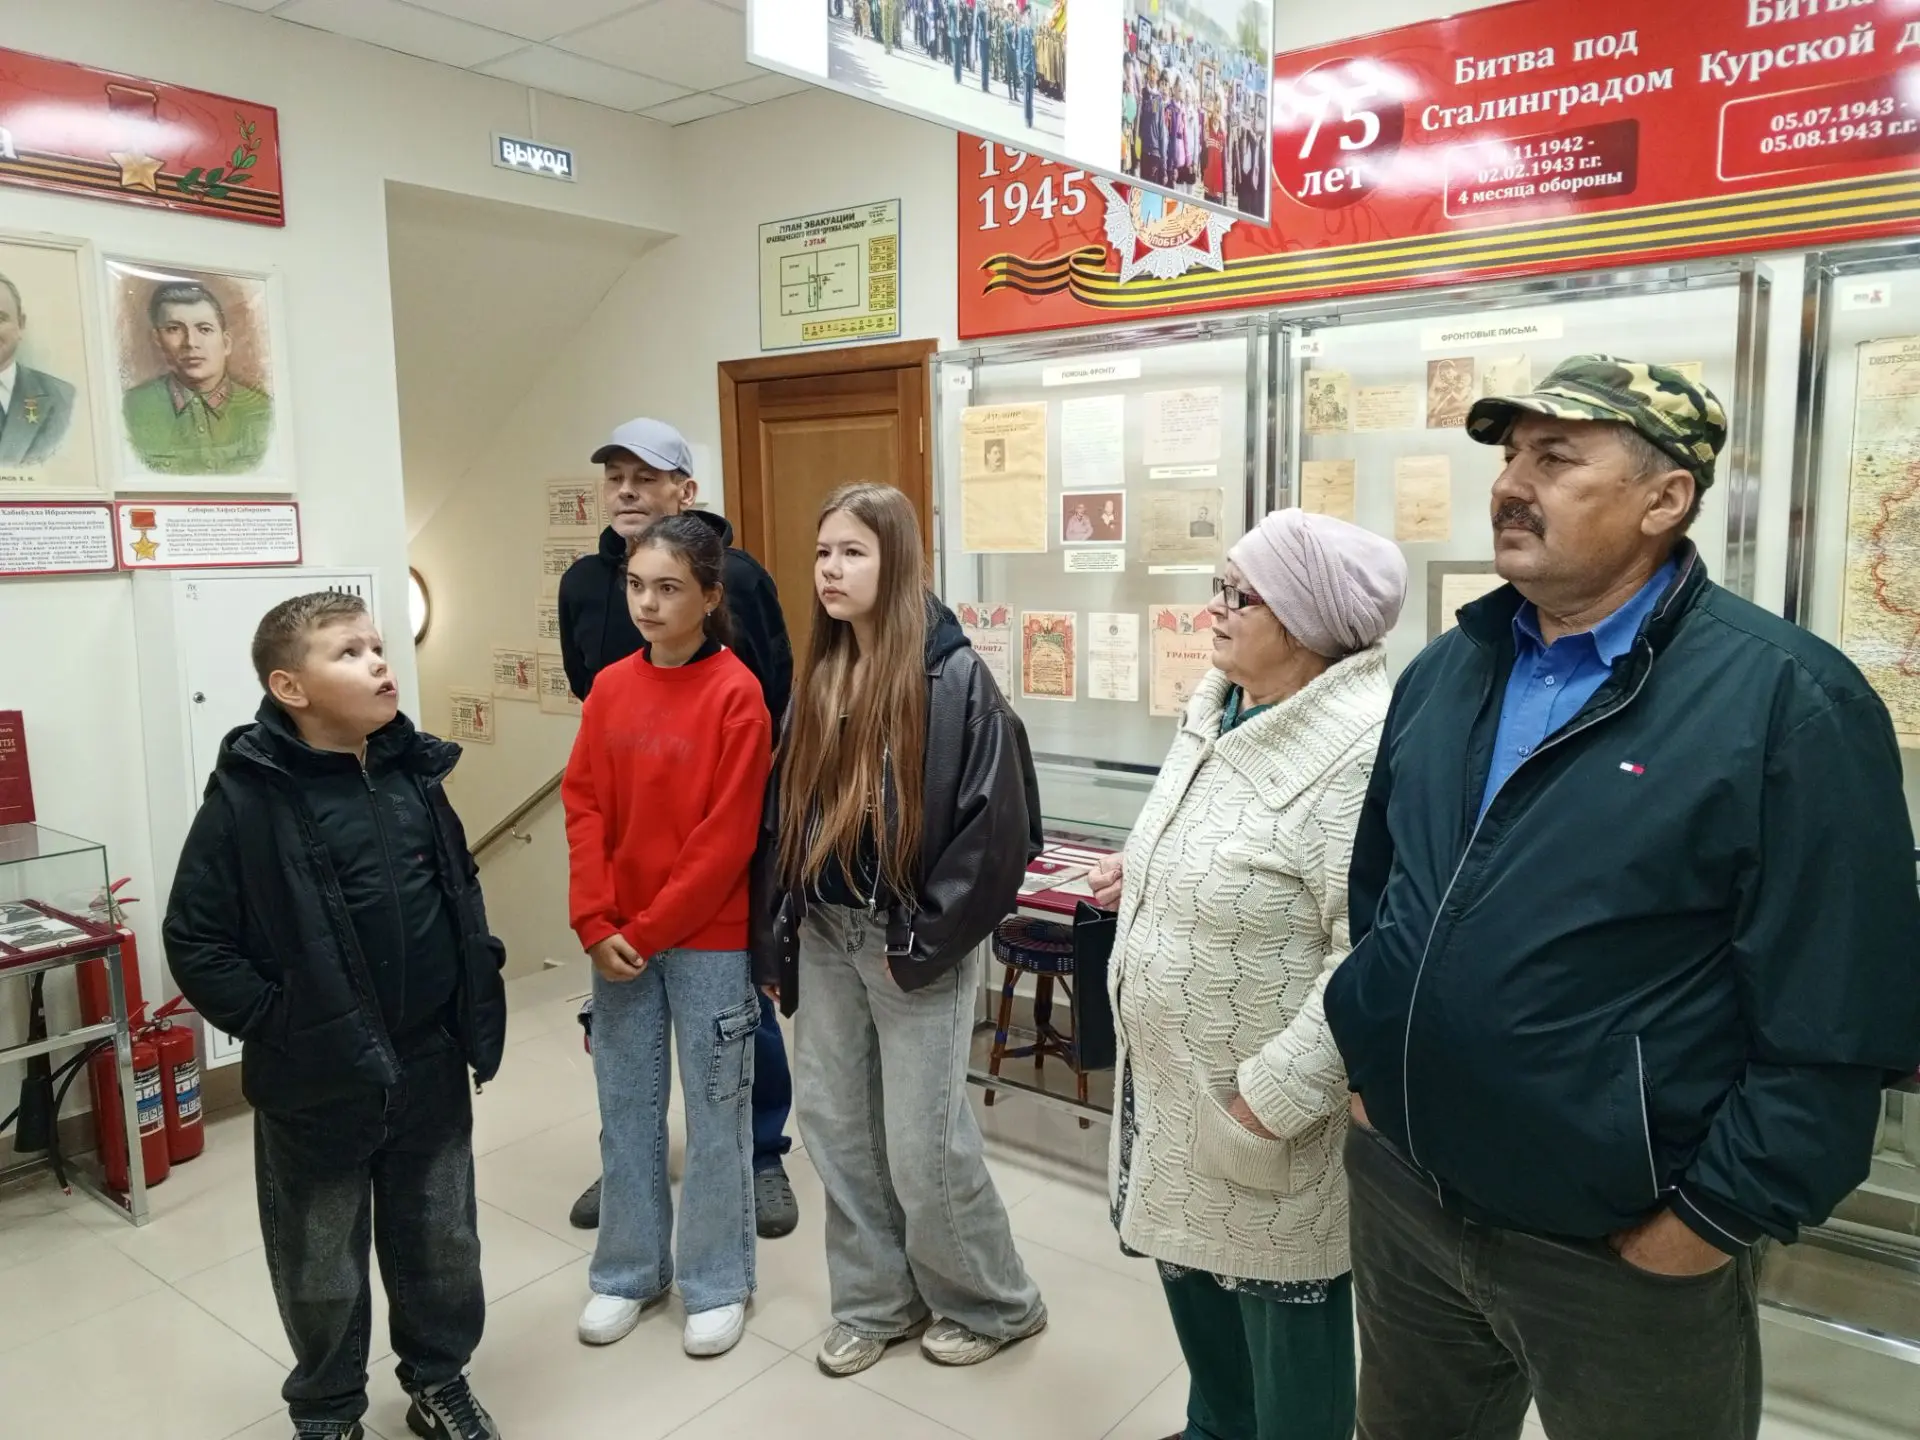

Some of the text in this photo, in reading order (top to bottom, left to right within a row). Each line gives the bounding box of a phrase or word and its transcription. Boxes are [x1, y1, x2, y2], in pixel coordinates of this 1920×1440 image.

[1454, 29, 1638, 85] Битва под
[1699, 21, 1877, 86] Курской
[1421, 67, 1675, 131] Сталинградом
[1770, 97, 1895, 132] 05.07.1943
[1298, 80, 1381, 160] 75
[1760, 118, 1918, 154] 05.08.1943 г.г.
[502, 140, 569, 173] ВЫХОД
[978, 139, 1055, 179] 19
[1477, 154, 1602, 184] 02.02.1943 г.г.
[1297, 164, 1363, 198] лет
[1458, 172, 1623, 205] 4 месяца обороны
[978, 169, 1087, 231] 1945
[779, 222, 802, 234] ПЛАН
[804, 213, 856, 229] ЭВАКУАЦИИ
[1151, 232, 1190, 247] ПОБЕДА
[808, 237, 827, 246] ЭТАЖ
[1440, 325, 1539, 342] ФРОНТОВЫЕ ПИСЬМА
[1089, 366, 1117, 376] ФРОНТУ
